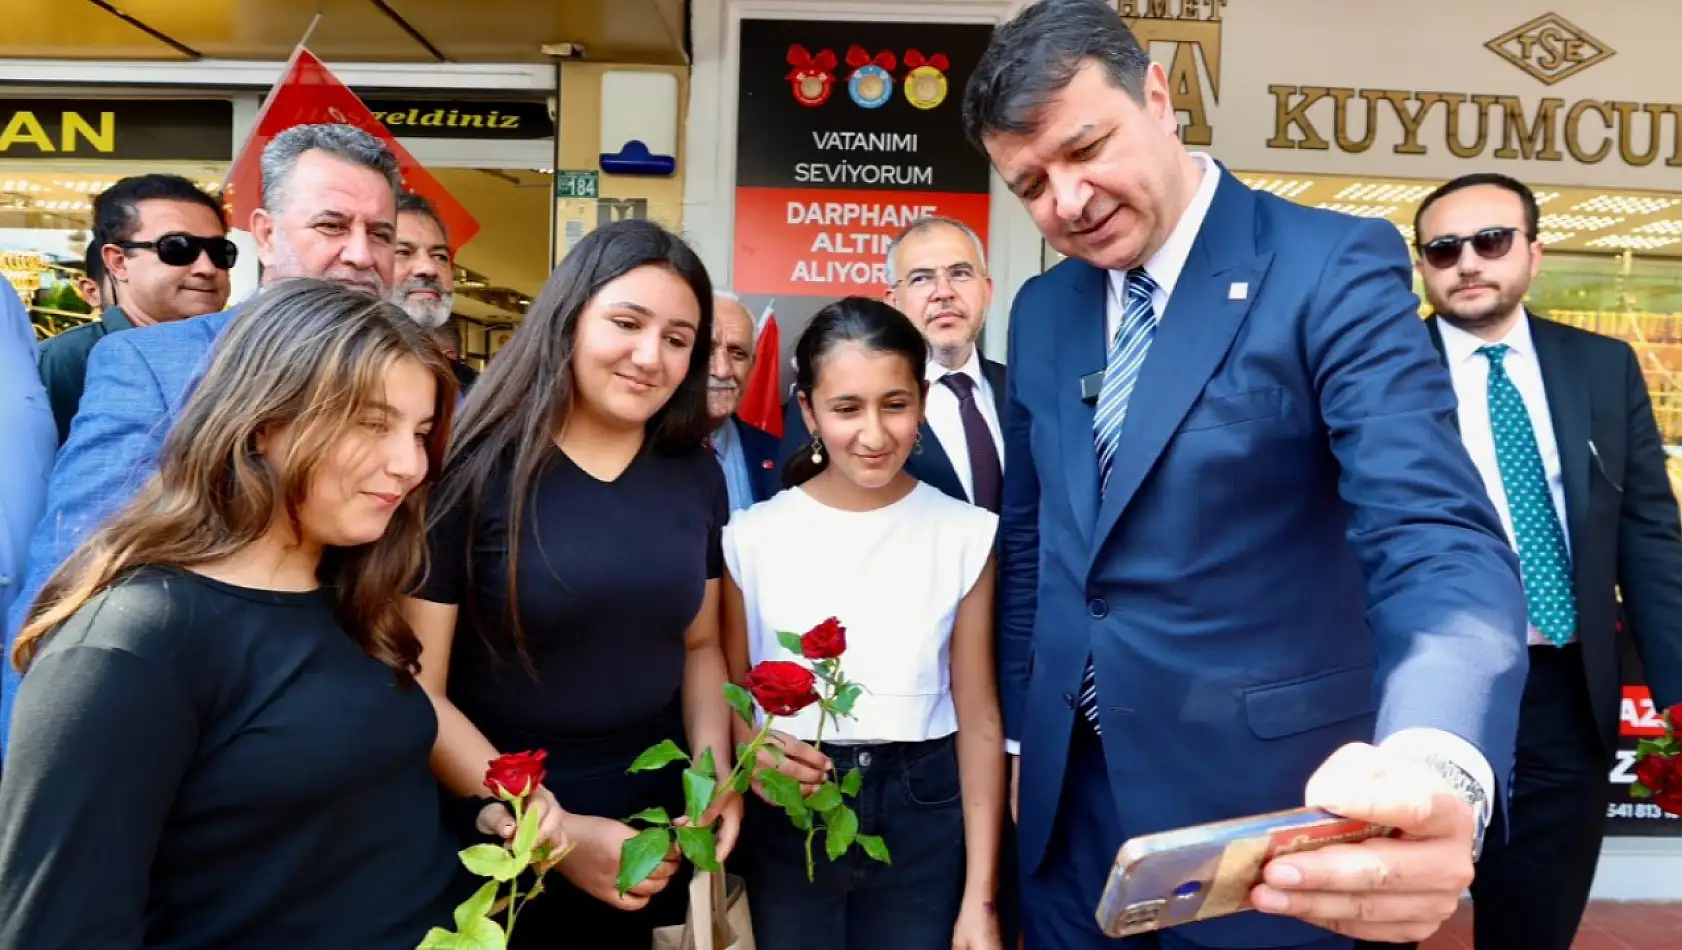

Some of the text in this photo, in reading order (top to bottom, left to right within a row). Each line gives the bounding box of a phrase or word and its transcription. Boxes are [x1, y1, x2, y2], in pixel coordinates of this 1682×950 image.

[1519, 28, 1584, 70] TSE
[0, 112, 115, 152] AN
[812, 131, 918, 152] VATANIMI
[794, 160, 933, 184] SEVİYORUM
[567, 175, 596, 196] 184
